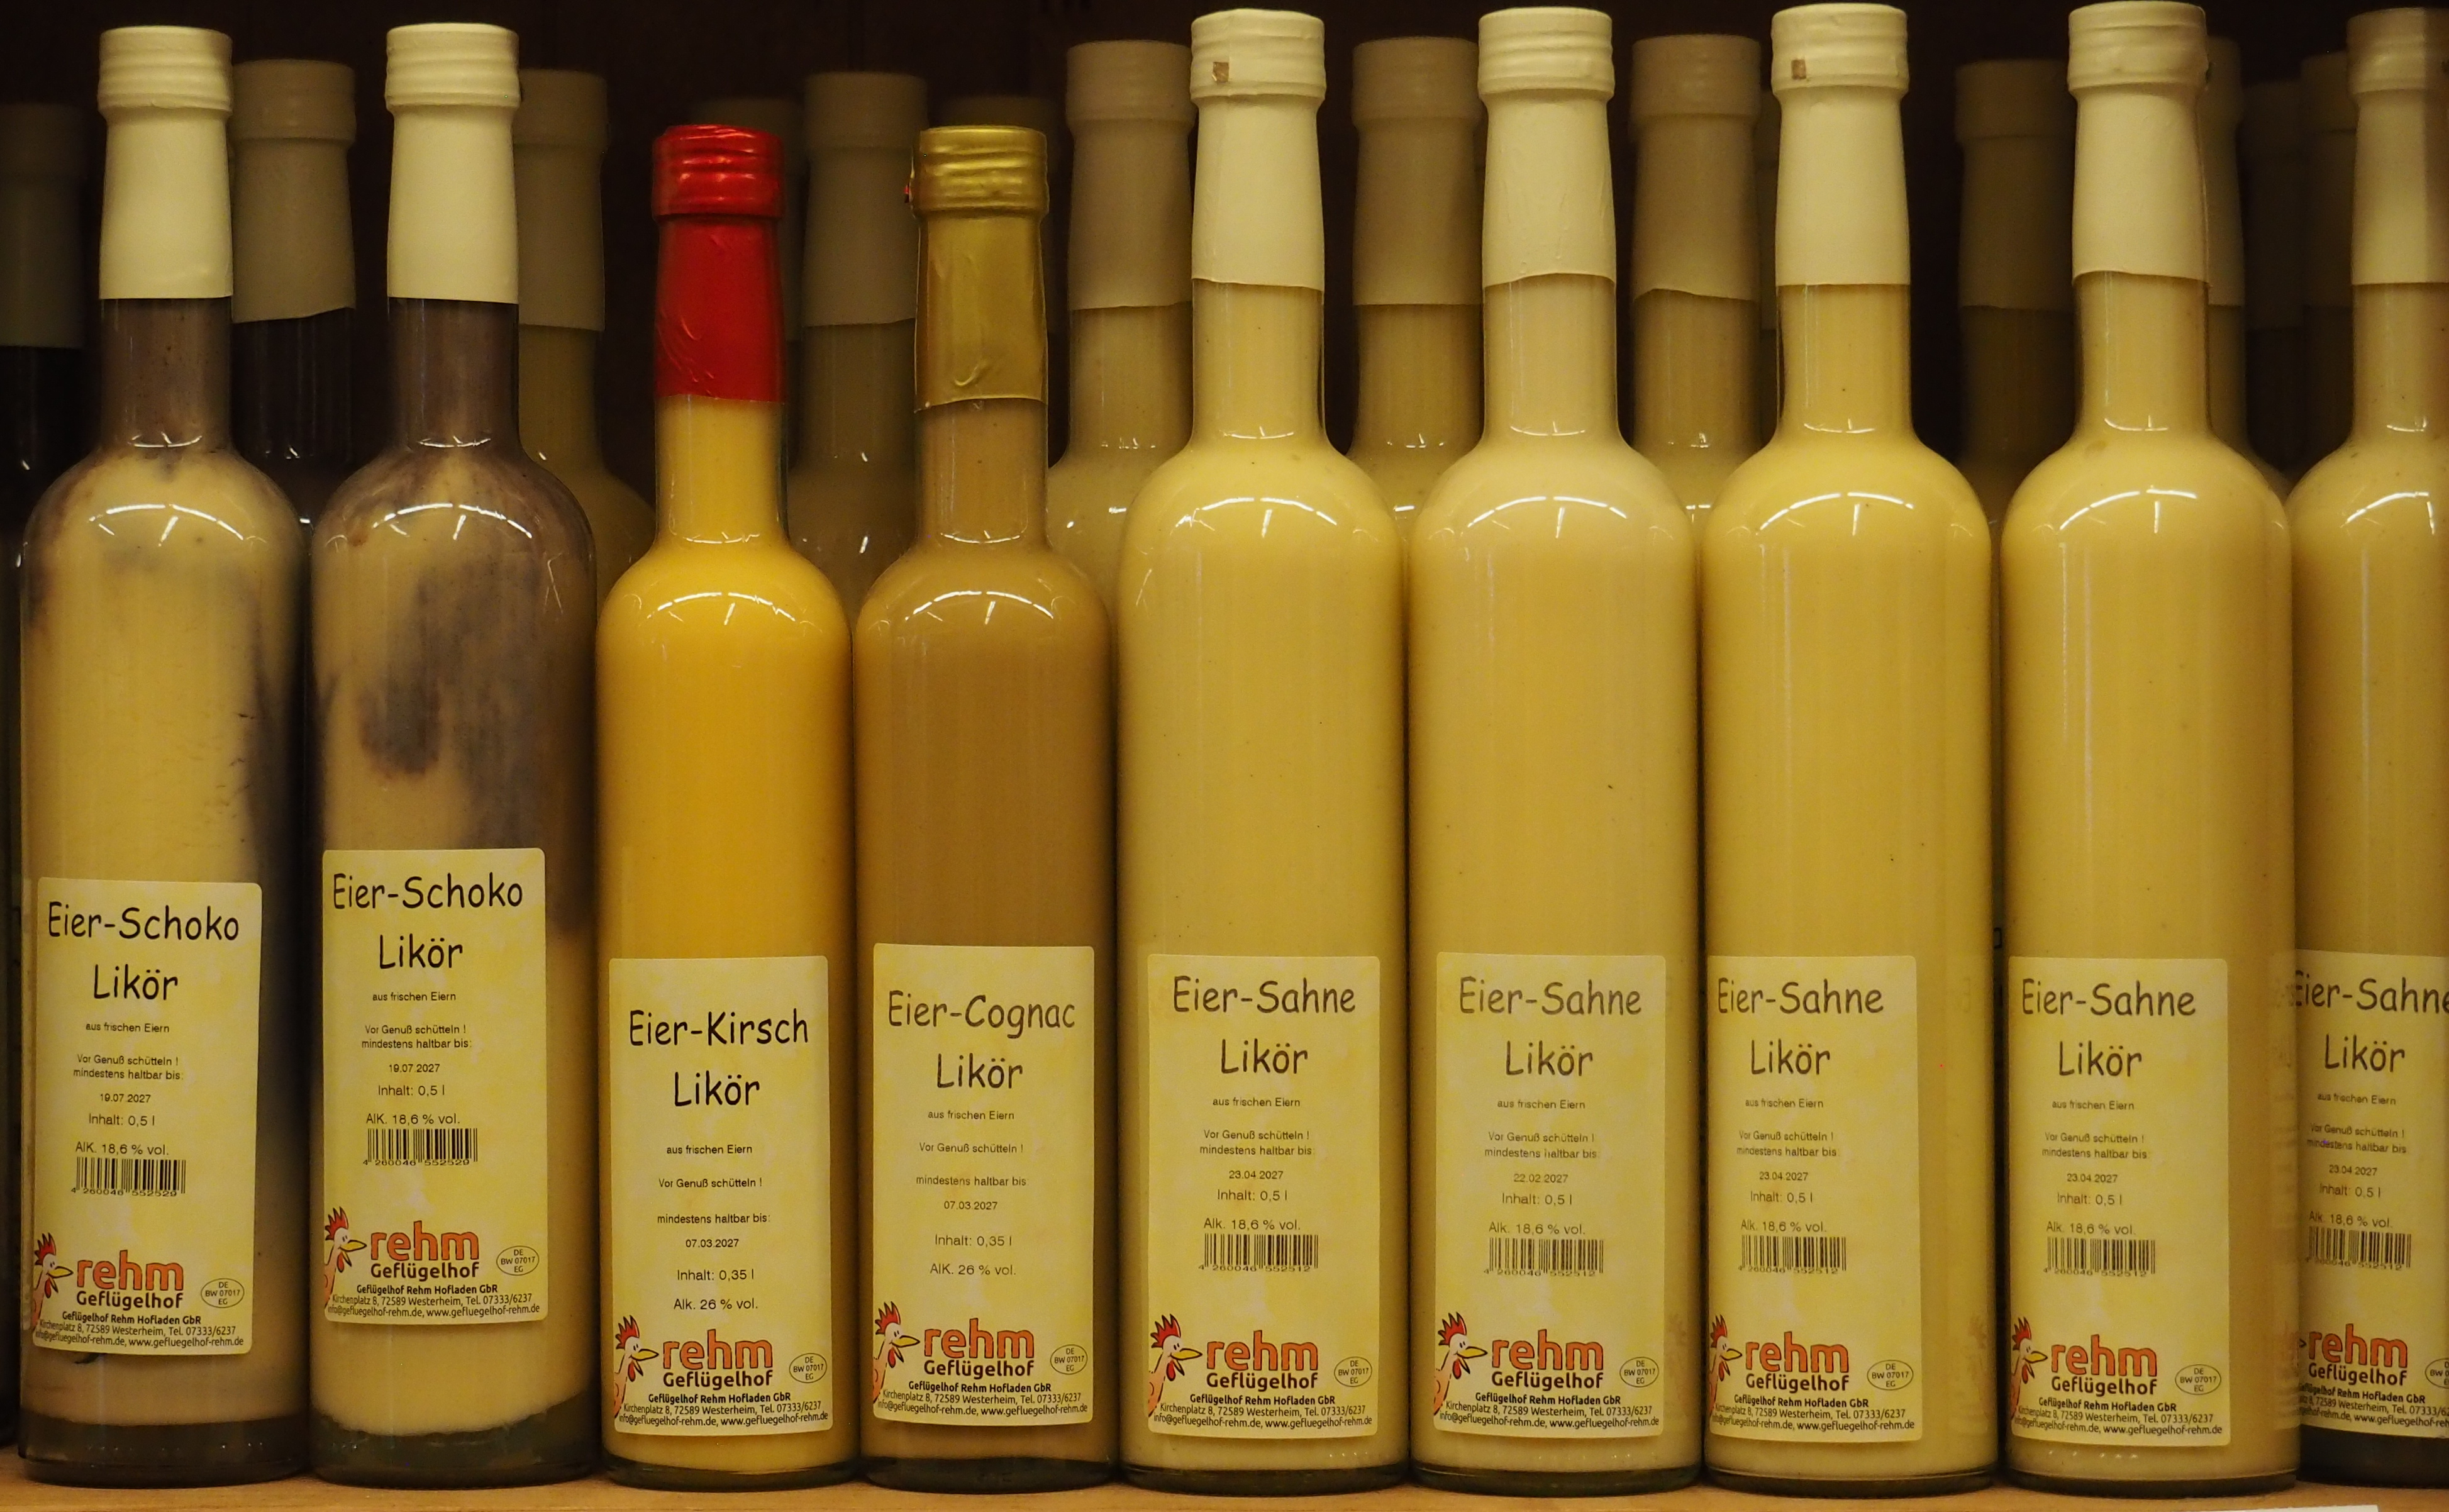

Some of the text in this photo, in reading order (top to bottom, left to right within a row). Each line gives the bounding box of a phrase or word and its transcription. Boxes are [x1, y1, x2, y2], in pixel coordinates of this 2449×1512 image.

[333, 872, 523, 909] Eier-Schoko
[48, 901, 239, 941] Eier-Schoko
[379, 933, 463, 969] Likör
[94, 964, 178, 1001] Likör
[1174, 976, 1355, 1013] Eier-Sahne
[1460, 976, 1641, 1015] Eier-Sahne
[1718, 977, 1884, 1014] Eier-Sahne
[2023, 978, 2196, 1016] Eier-Sahne
[889, 990, 1075, 1039] Eier-Cognac
[630, 1008, 808, 1046] Eier-Kirsch
[1221, 1038, 1308, 1074] Likör
[1506, 1040, 1593, 1076] Likör
[1751, 1038, 1830, 1076] Likör
[2059, 1040, 2142, 1077] Likör
[2324, 1034, 2405, 1073] Likör
[937, 1053, 1023, 1089] Likör
[379, 1085, 413, 1096] Inhalt:
[418, 1085, 438, 1096] 0,5
[674, 1070, 760, 1107] Likör
[89, 1113, 123, 1125] Inhalt:
[128, 1116, 147, 1127] 0,5
[392, 1114, 418, 1126] 18,6
[423, 1115, 434, 1125] %
[438, 1113, 460, 1124] vol.
[948, 1110, 986, 1120] frischen
[989, 1111, 1014, 1120] Eiern
[686, 1145, 724, 1154] frischen
[727, 1144, 752, 1153] Eiern
[659, 1179, 673, 1187] Vor
[676, 1179, 708, 1187] Genuß
[711, 1178, 756, 1187] schütteln
[1218, 1189, 1255, 1201] Inhalt:
[1260, 1191, 1280, 1201] 0,5
[1502, 1193, 1539, 1204] Inhalt:
[1545, 1194, 1565, 1206] 0,5
[1751, 1191, 1783, 1203] Inhalt:
[1787, 1192, 1806, 1204] 0,5
[2058, 1193, 2091, 1204] Inhalt:
[2096, 1194, 2114, 1206] 0,5
[657, 1214, 711, 1224] mindestens
[715, 1214, 750, 1223] haltbar
[1204, 1218, 1300, 1230] Alk. 18,6 % vol.
[1489, 1221, 1585, 1235] Alk. 18,6 % vol.
[370, 1220, 479, 1263] rehm
[686, 1238, 739, 1248] 07.03.2027
[935, 1235, 971, 1245] Inhalt:
[977, 1236, 1004, 1247] 0,35
[77, 1249, 184, 1292] rehm
[370, 1260, 479, 1282] Geflügelhof
[514, 1256, 535, 1264] 07017
[677, 1269, 714, 1281] Inhalt:
[719, 1269, 747, 1281] 0,35
[76, 1289, 184, 1311] Geflügelhof
[357, 1284, 498, 1296] Geflügelhof Rehm Hofladen GbR
[674, 1298, 758, 1309] Alk. 26 % vol.
[62, 1311, 201, 1325] Geflügelhof Rehm Hofladen GbR
[663, 1328, 773, 1371] rehm
[924, 1318, 1035, 1360] rehm
[1491, 1328, 1604, 1372] rehm
[2307, 1321, 2408, 1369] rehm
[1206, 1330, 1319, 1372] rehm
[1745, 1331, 1850, 1375] rehm
[2051, 1333, 2158, 1379] rehm
[663, 1368, 773, 1391] Geflügelhof
[924, 1358, 1035, 1380] Geflügelhof
[2307, 1361, 2408, 1387] Geflügelhof
[909, 1381, 1052, 1393] Geflügelhof Rehm Hofladen GbR
[1206, 1370, 1318, 1392] Geflügelhof
[1491, 1369, 1604, 1392] Geflügelhof
[1746, 1372, 1850, 1394] Geflügelhof
[2052, 1374, 2158, 1398] Geflügelhof
[648, 1391, 791, 1405] Geflügelhof Rehm Hofladen GbR
[1190, 1393, 1335, 1407] Geflügelhof Rehm Hofladen GbR
[1475, 1392, 1621, 1406] Geflügelhof Rehm Hofladen GbR
[1734, 1394, 1869, 1408] Geflügelhof Rehm Hofladen GbR
[2039, 1397, 2177, 1412] Geflügelhof Rehm Hofladen GbR
[2337, 1388, 2360, 1399] Rehm
[2362, 1391, 2404, 1403] Hofladen
[2406, 1394, 2426, 1404] GbR
[623, 1401, 821, 1416] Kirchenplatz 8, 72589 Westerheim, Tel. 07333/6237
[1159, 1403, 1365, 1418] Kirchenplatz 8, 72589 Westerheim, Tel. 07333/6237
